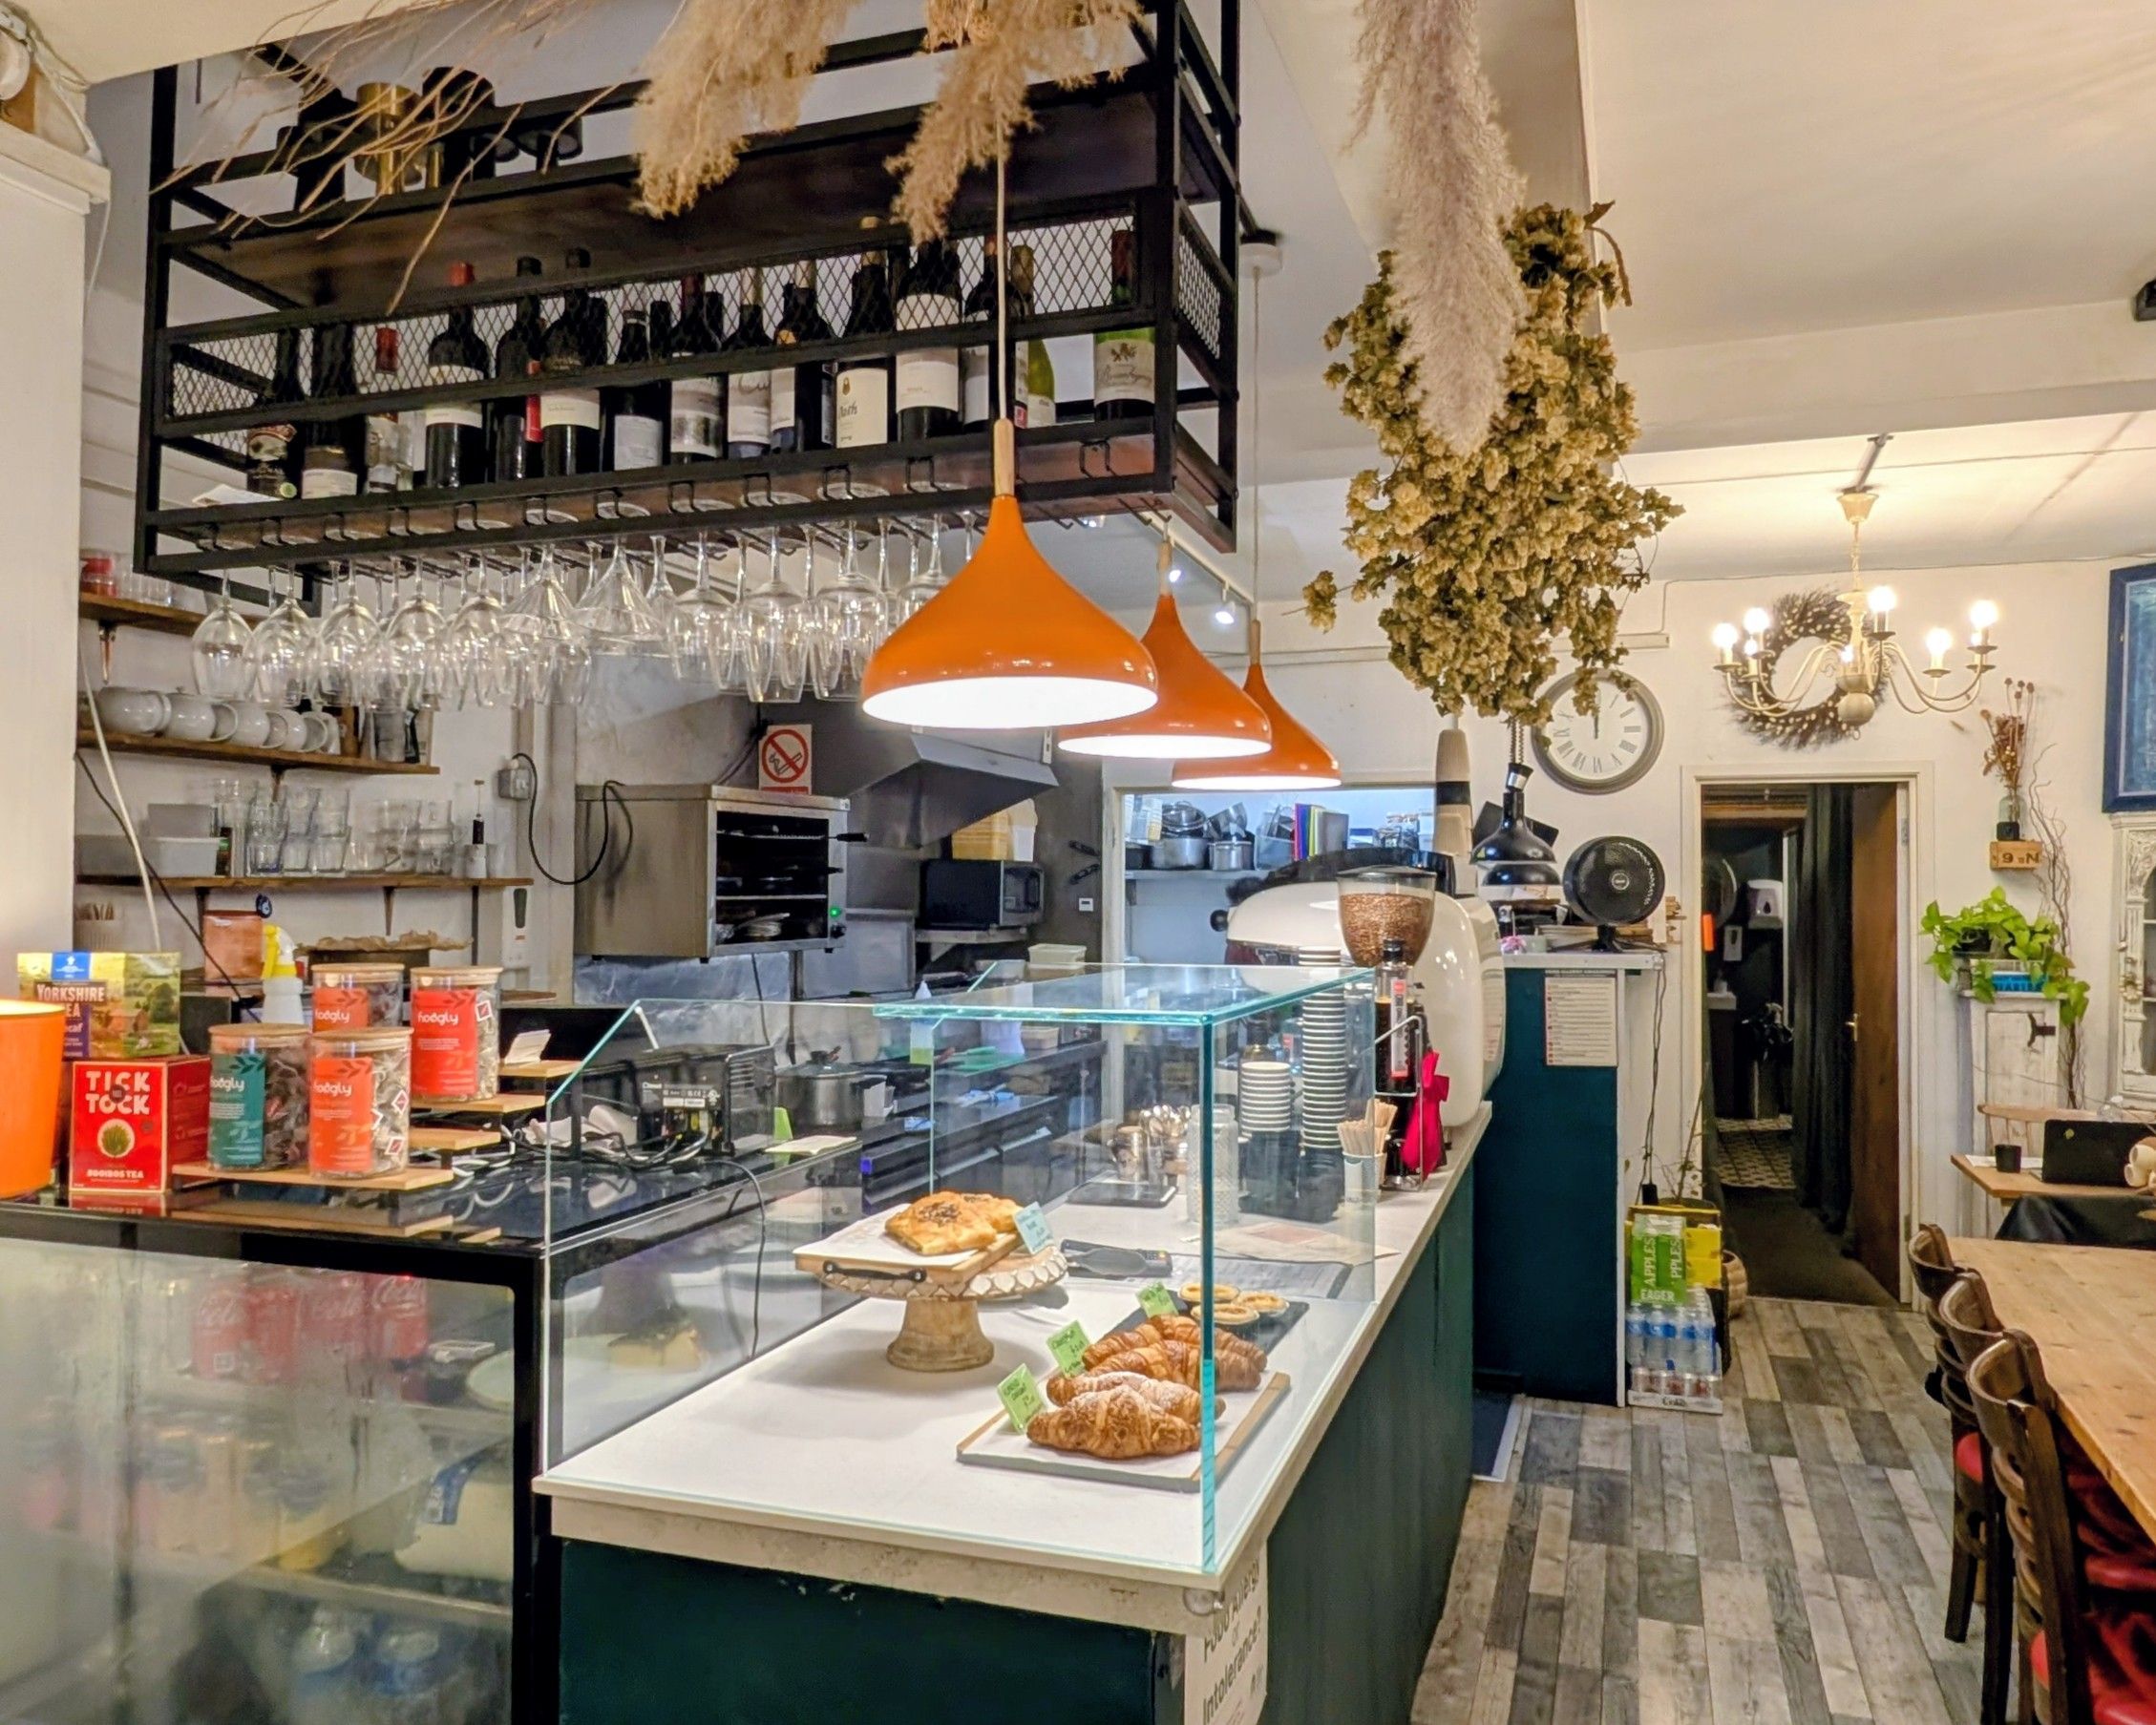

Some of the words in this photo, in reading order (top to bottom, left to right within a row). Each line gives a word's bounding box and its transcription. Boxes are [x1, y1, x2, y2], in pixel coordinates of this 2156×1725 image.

[36, 983, 105, 1002] YORKSHIRE
[65, 1003, 81, 1018] EA
[85, 1070, 151, 1093] TICK
[85, 1093, 151, 1115] TOCK
[86, 1168, 126, 1180] ROOIBOS
[127, 1169, 144, 1180] TEA
[1643, 1236, 1658, 1287] APPLES
[1669, 1238, 1683, 1279] PPLES
[1639, 1288, 1676, 1302] EAGER
[1202, 1605, 1262, 1725] Intolerance?
